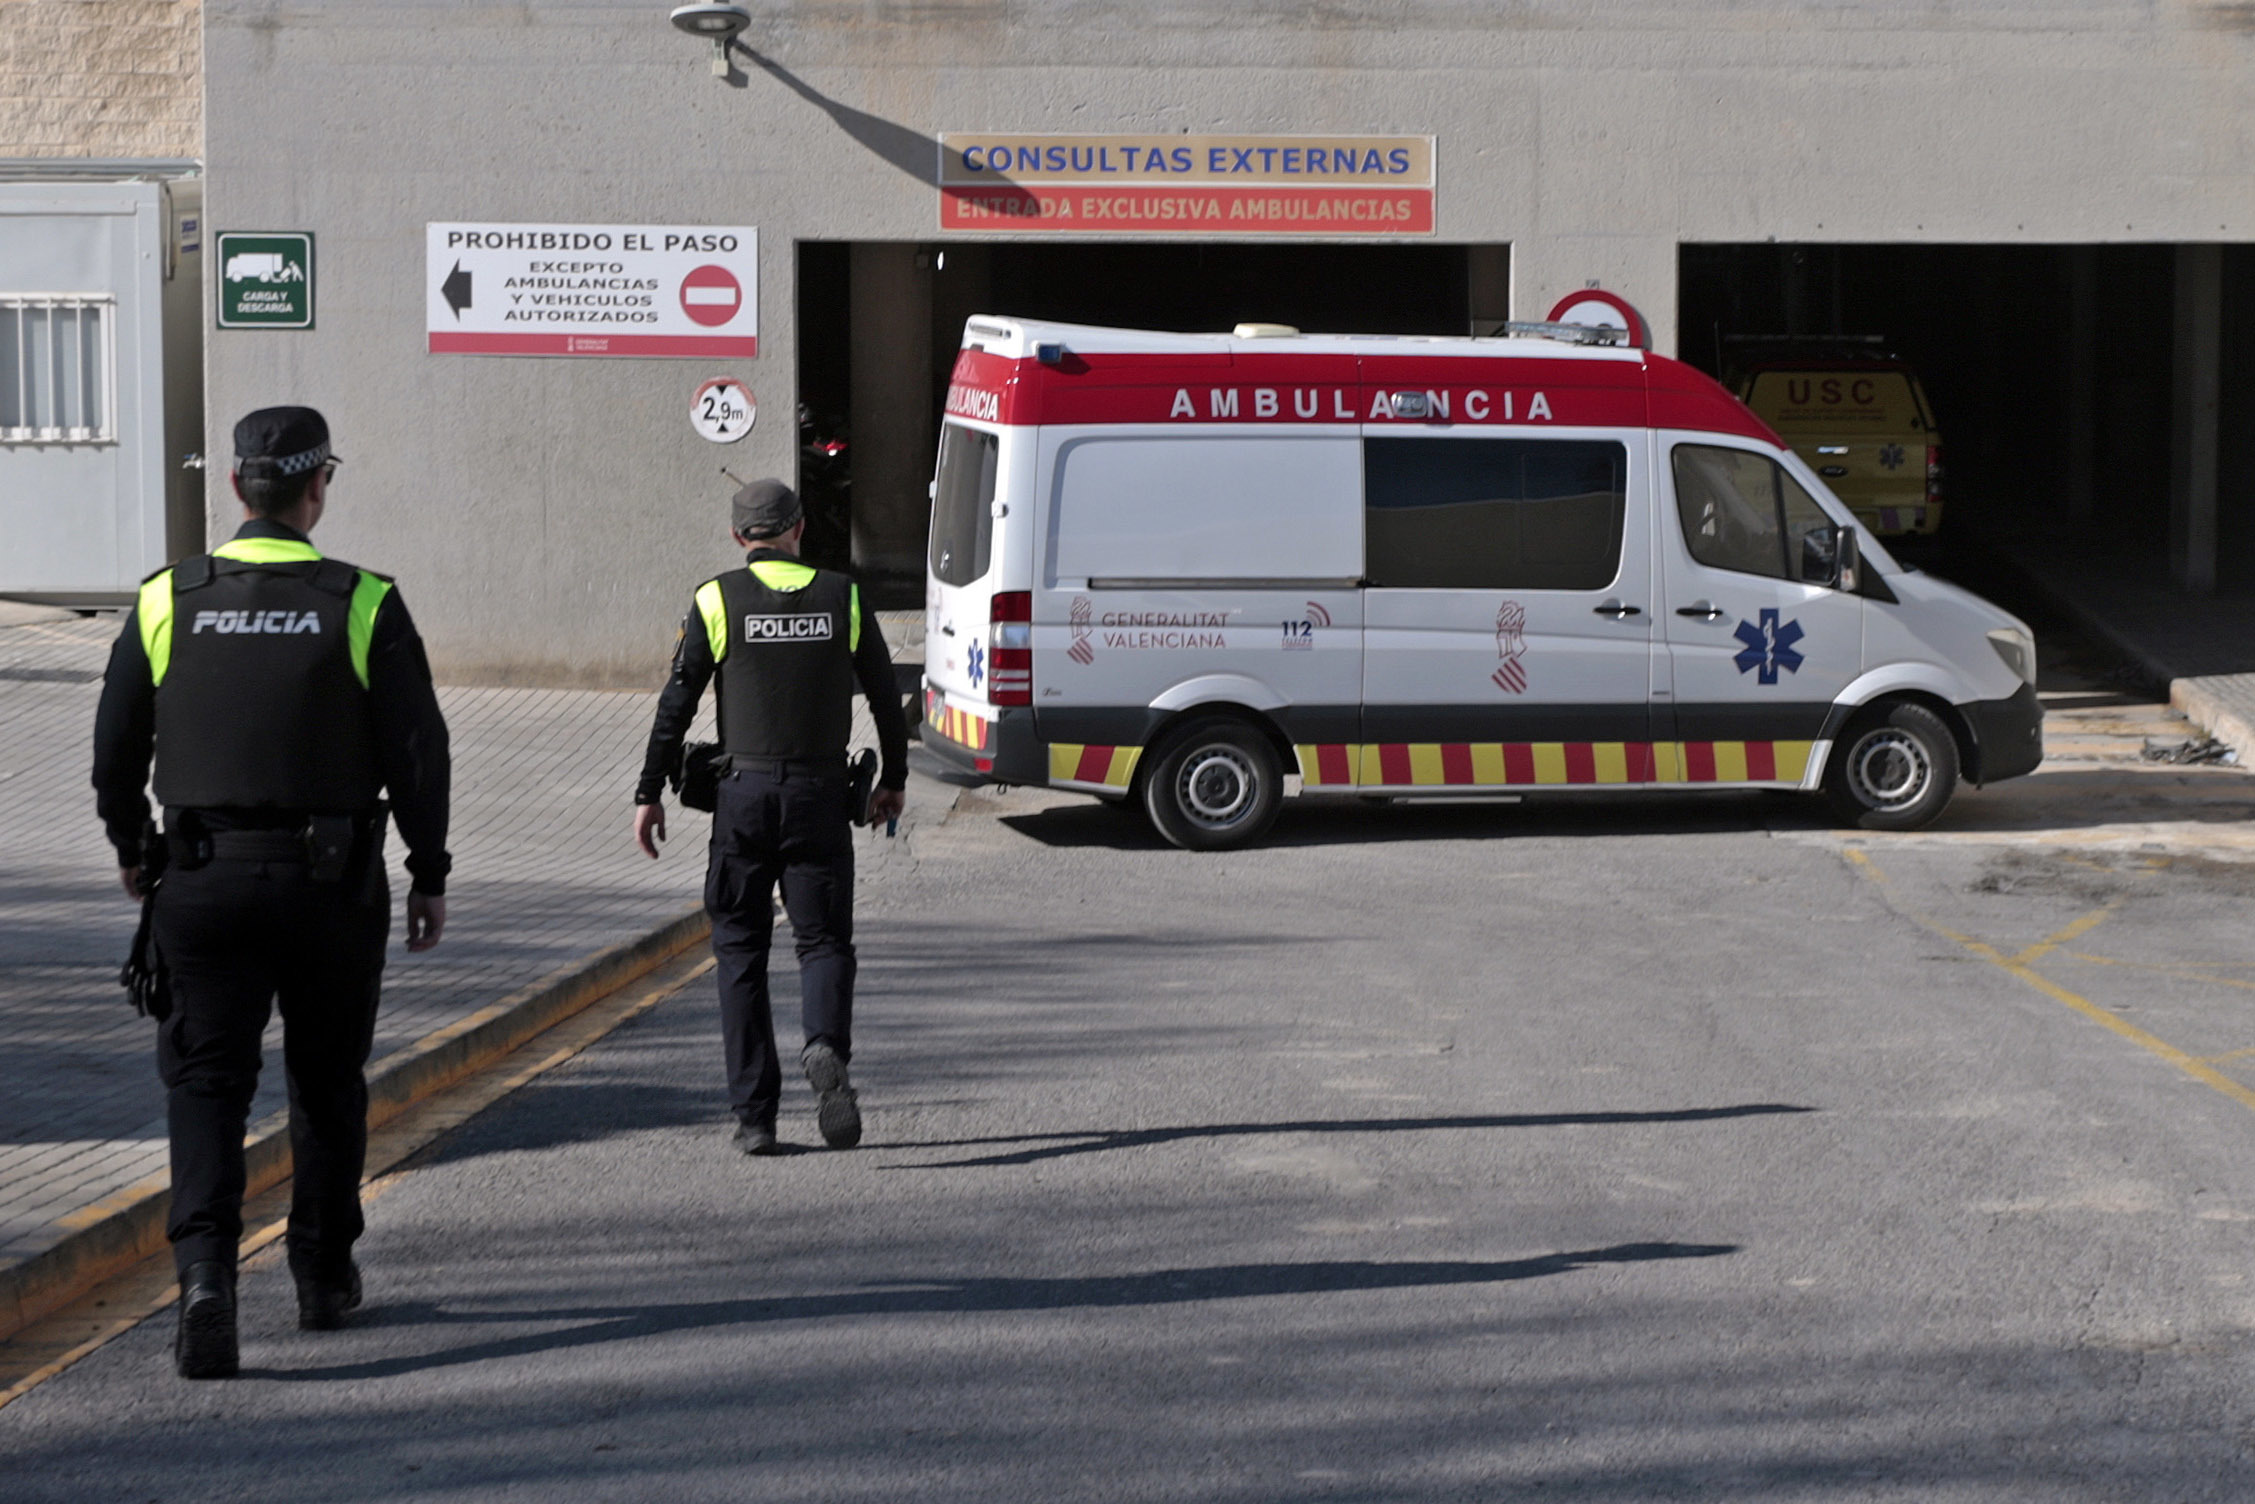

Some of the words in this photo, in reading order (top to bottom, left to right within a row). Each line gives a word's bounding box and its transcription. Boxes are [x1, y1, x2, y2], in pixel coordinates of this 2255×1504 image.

[962, 145, 1193, 173] CONSULTAS
[1208, 147, 1410, 174] EXTERNAS
[956, 198, 1072, 219] ENTRADA
[1081, 198, 1221, 220] EXCLUSIVA
[1230, 199, 1411, 221] AMBULANCIAS
[448, 231, 612, 251] PROHIBIDO
[623, 234, 654, 251] EL
[664, 234, 738, 252] PASO
[529, 261, 624, 274] EXCEPTO
[504, 277, 658, 290] AMBULANCIAS
[242, 291, 279, 301] CARGA
[280, 291, 288, 301] Y
[511, 294, 523, 305] Y
[530, 294, 653, 307] VEHICULOS
[237, 302, 293, 313] DESCARGA
[504, 310, 658, 323] AUTORIZADOS
[1788, 379, 1875, 405] USC
[1170, 389, 1554, 421] AMBULANCIA
[192, 610, 320, 634] POLICIA
[749, 618, 828, 637] POLICIA
[1102, 613, 1229, 628] GENERALITAT
[1281, 620, 1312, 637] 112
[1104, 632, 1226, 648] VALENCIANA
